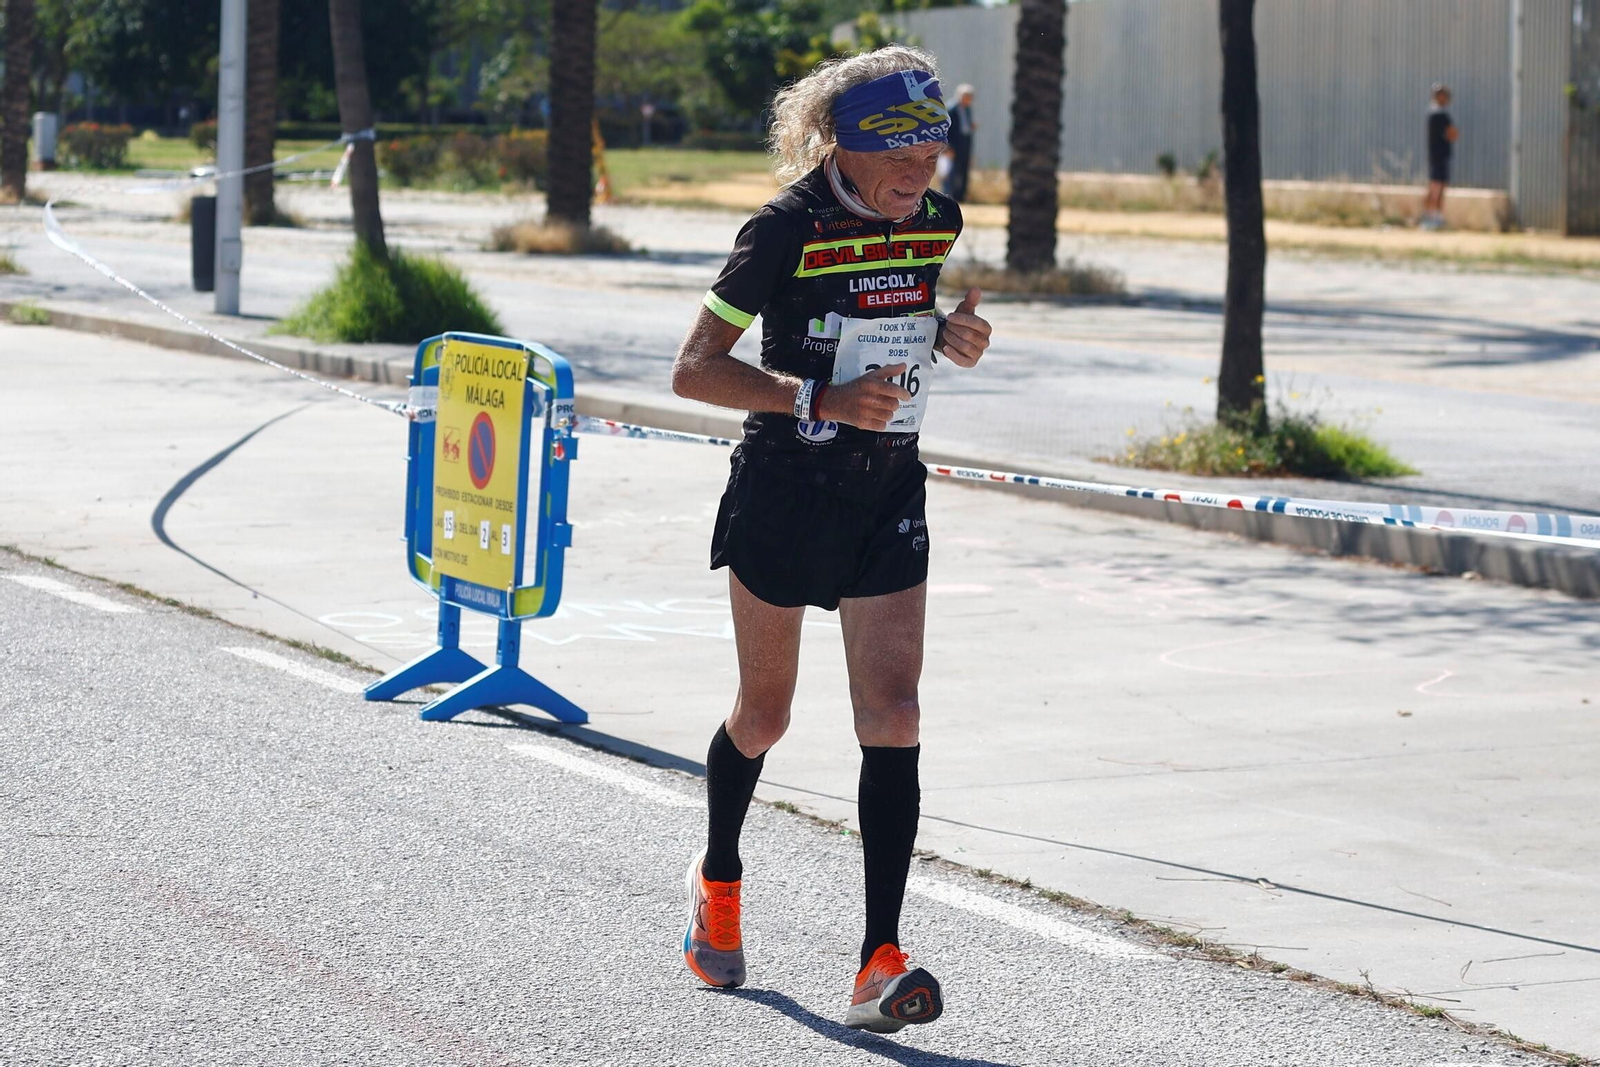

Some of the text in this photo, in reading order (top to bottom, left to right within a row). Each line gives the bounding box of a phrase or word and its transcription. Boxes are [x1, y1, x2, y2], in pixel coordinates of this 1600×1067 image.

[826, 218, 863, 231] vitelsa
[804, 243, 863, 270] DEVIL
[863, 240, 907, 260] BIKE
[849, 273, 916, 293] LINCOLN
[867, 290, 923, 306] ELECTRIC
[857, 334, 890, 344] CIUDAD
[891, 336, 902, 344] DE
[888, 349, 909, 357] 2025
[455, 353, 522, 381] POLICÍA LOCAL
[465, 385, 505, 409] MÁLAGA
[435, 486, 513, 513] PROHIBIDO ESTACIONAR DESDE
[444, 517, 453, 531] 15
[458, 522, 468, 535] DEL
[482, 528, 487, 543] 2
[491, 530, 498, 542] AL
[502, 532, 508, 547] 3
[443, 550, 460, 564] MOTIVO
[461, 555, 468, 566] DE
